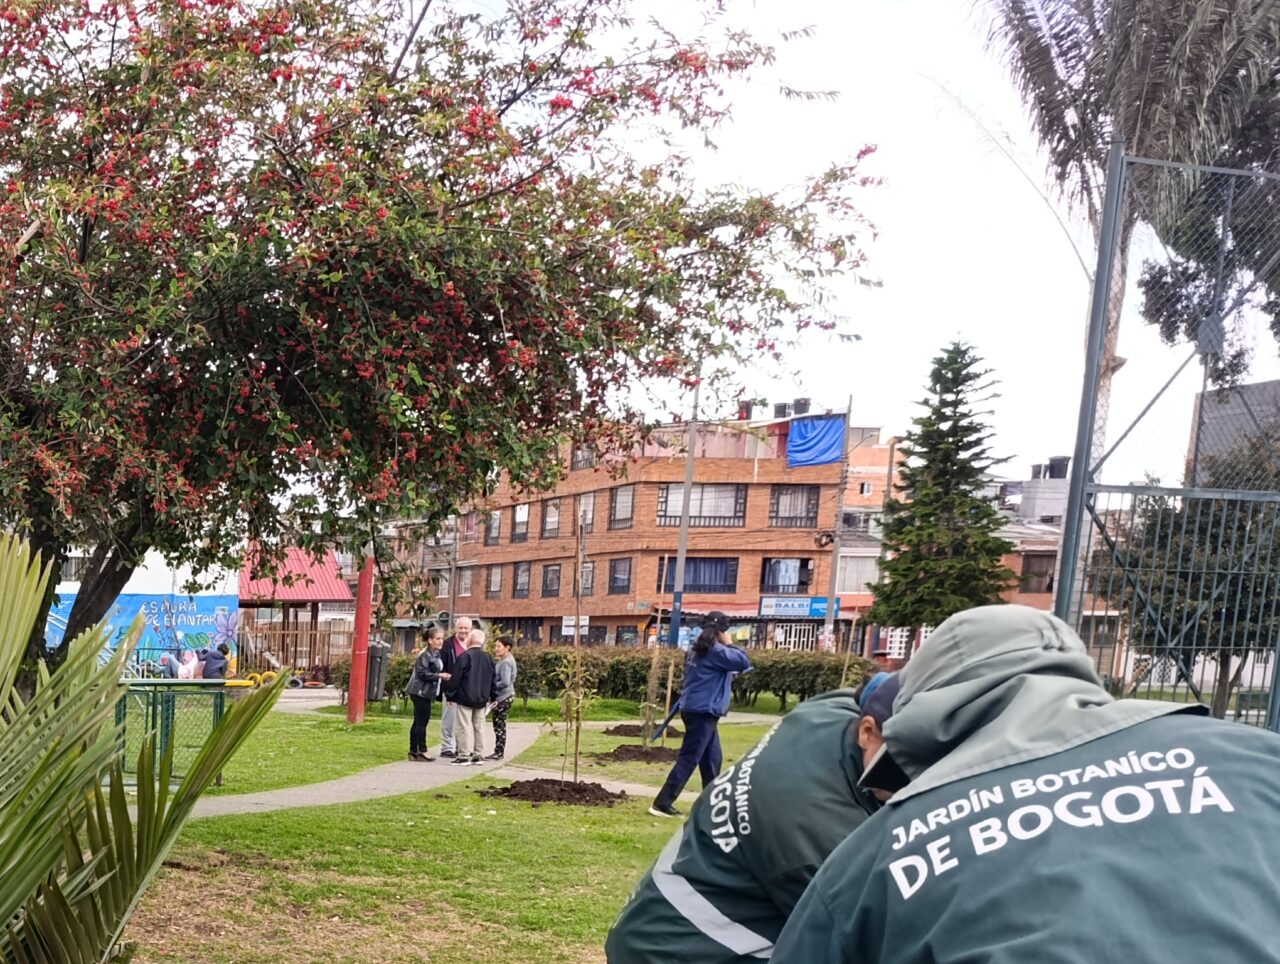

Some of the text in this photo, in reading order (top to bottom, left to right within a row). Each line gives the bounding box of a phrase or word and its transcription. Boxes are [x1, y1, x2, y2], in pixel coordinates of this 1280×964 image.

[141, 601, 158, 613] ES
[889, 767, 1235, 900] DE BOGOTÁ
[892, 786, 1004, 850] JARDÍN
